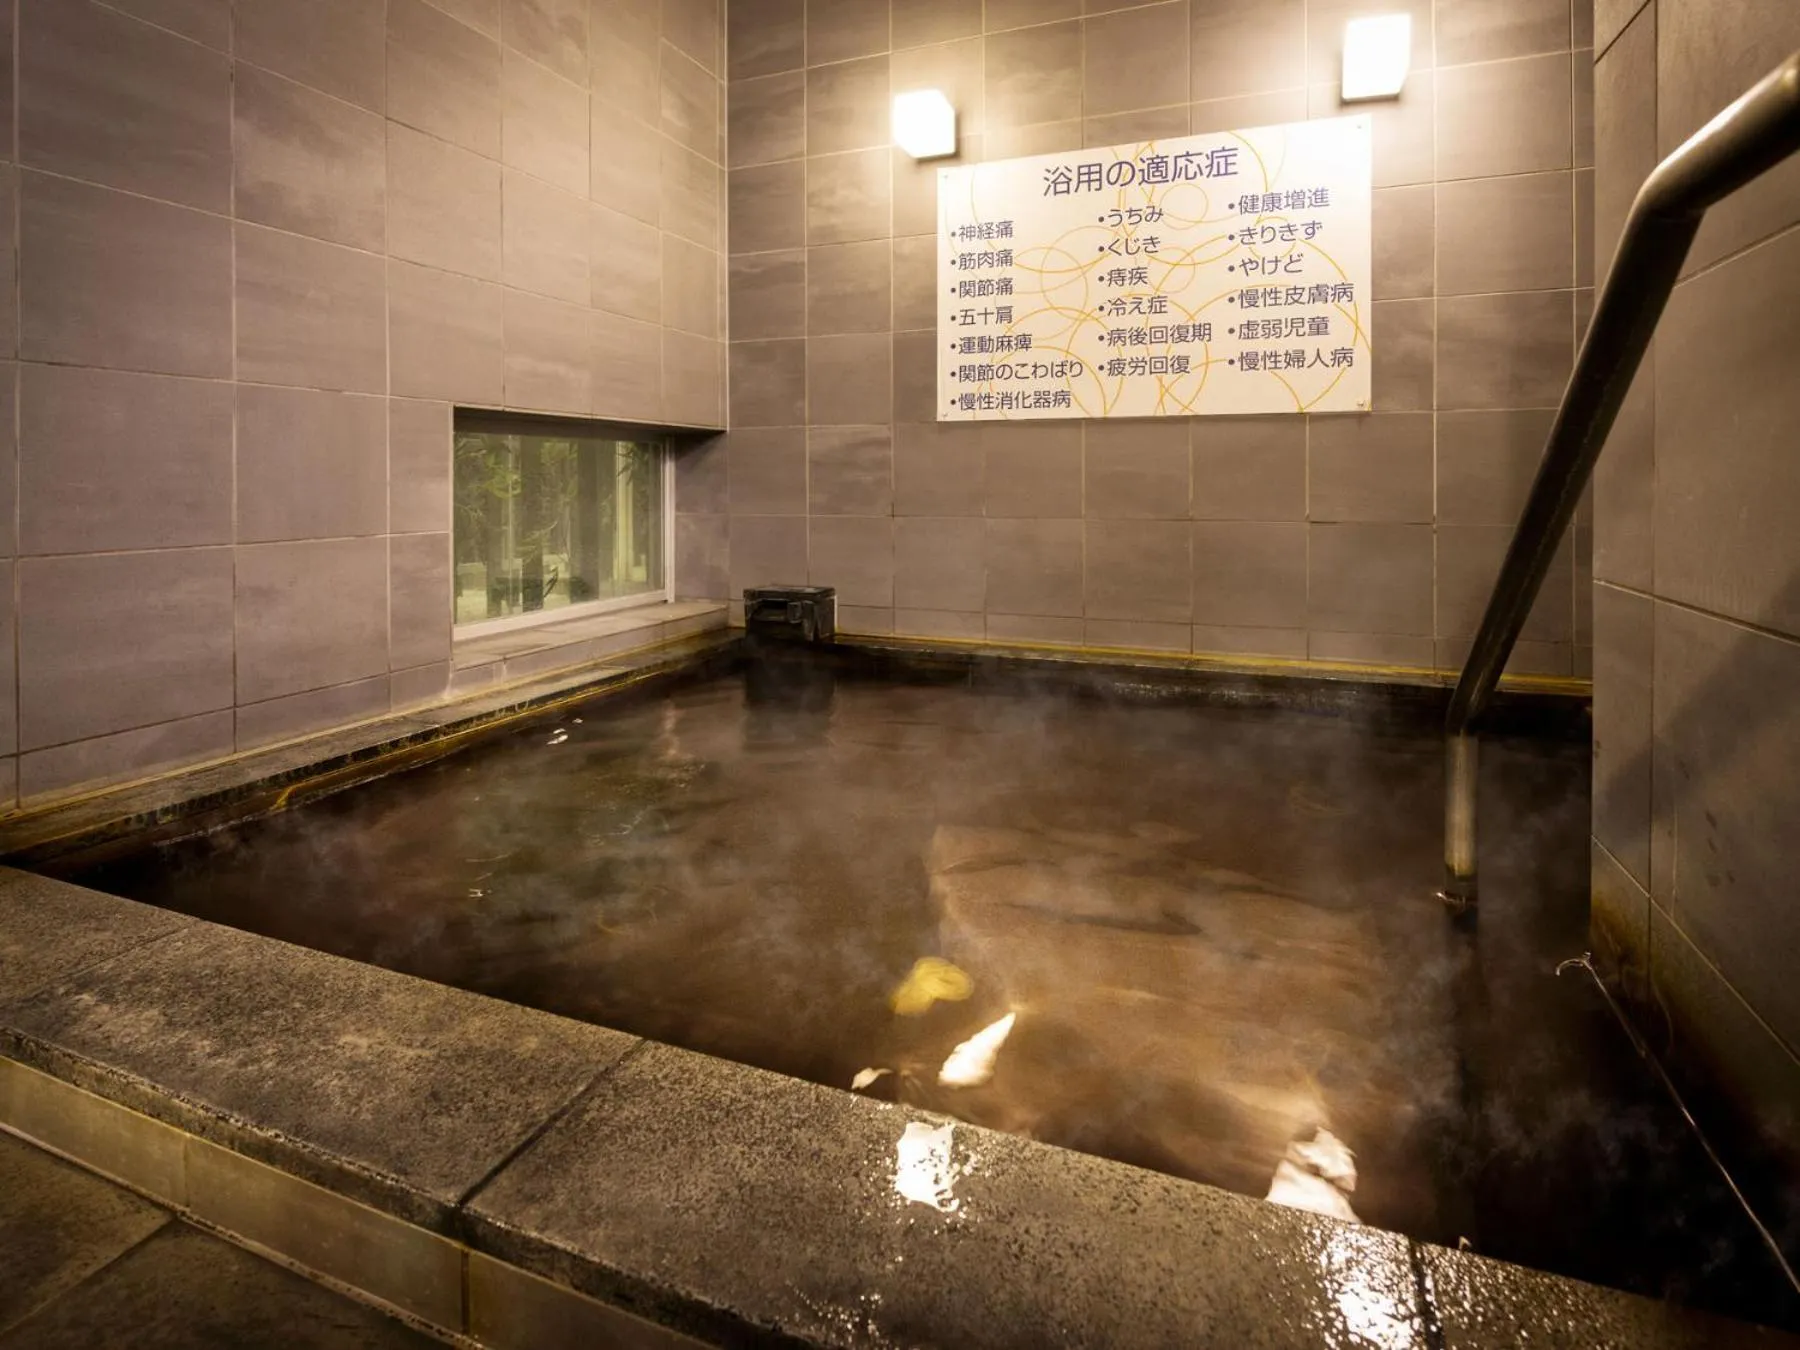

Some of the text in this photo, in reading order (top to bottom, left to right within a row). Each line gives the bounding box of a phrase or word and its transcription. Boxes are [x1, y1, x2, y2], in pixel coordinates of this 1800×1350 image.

[1043, 146, 1239, 197] 浴用の適応症
[1238, 187, 1330, 216] 健康増進
[1108, 205, 1164, 228] うちみ
[958, 220, 1014, 242] 神経痛
[1238, 220, 1323, 246] きりきず
[1108, 235, 1161, 256] くじき
[958, 248, 1014, 271] 筋肉痛
[1238, 253, 1304, 277] やけど
[958, 277, 1014, 299] 関節痛
[1106, 266, 1149, 288] 痔疾
[1106, 295, 1169, 317] 冷え症
[1237, 282, 1354, 310] 慢性皮膚病
[958, 305, 1013, 326] 五十肩
[1106, 322, 1213, 347] 病後回復期
[1237, 316, 1331, 341] 虚弱児童
[958, 333, 1033, 355] 運動麻痺
[1106, 354, 1192, 377] 疲労回復
[1237, 346, 1354, 372] 慢性婦人病
[958, 360, 1084, 383] 関節のこわばり
[958, 389, 1072, 411] 慢性消化器病
